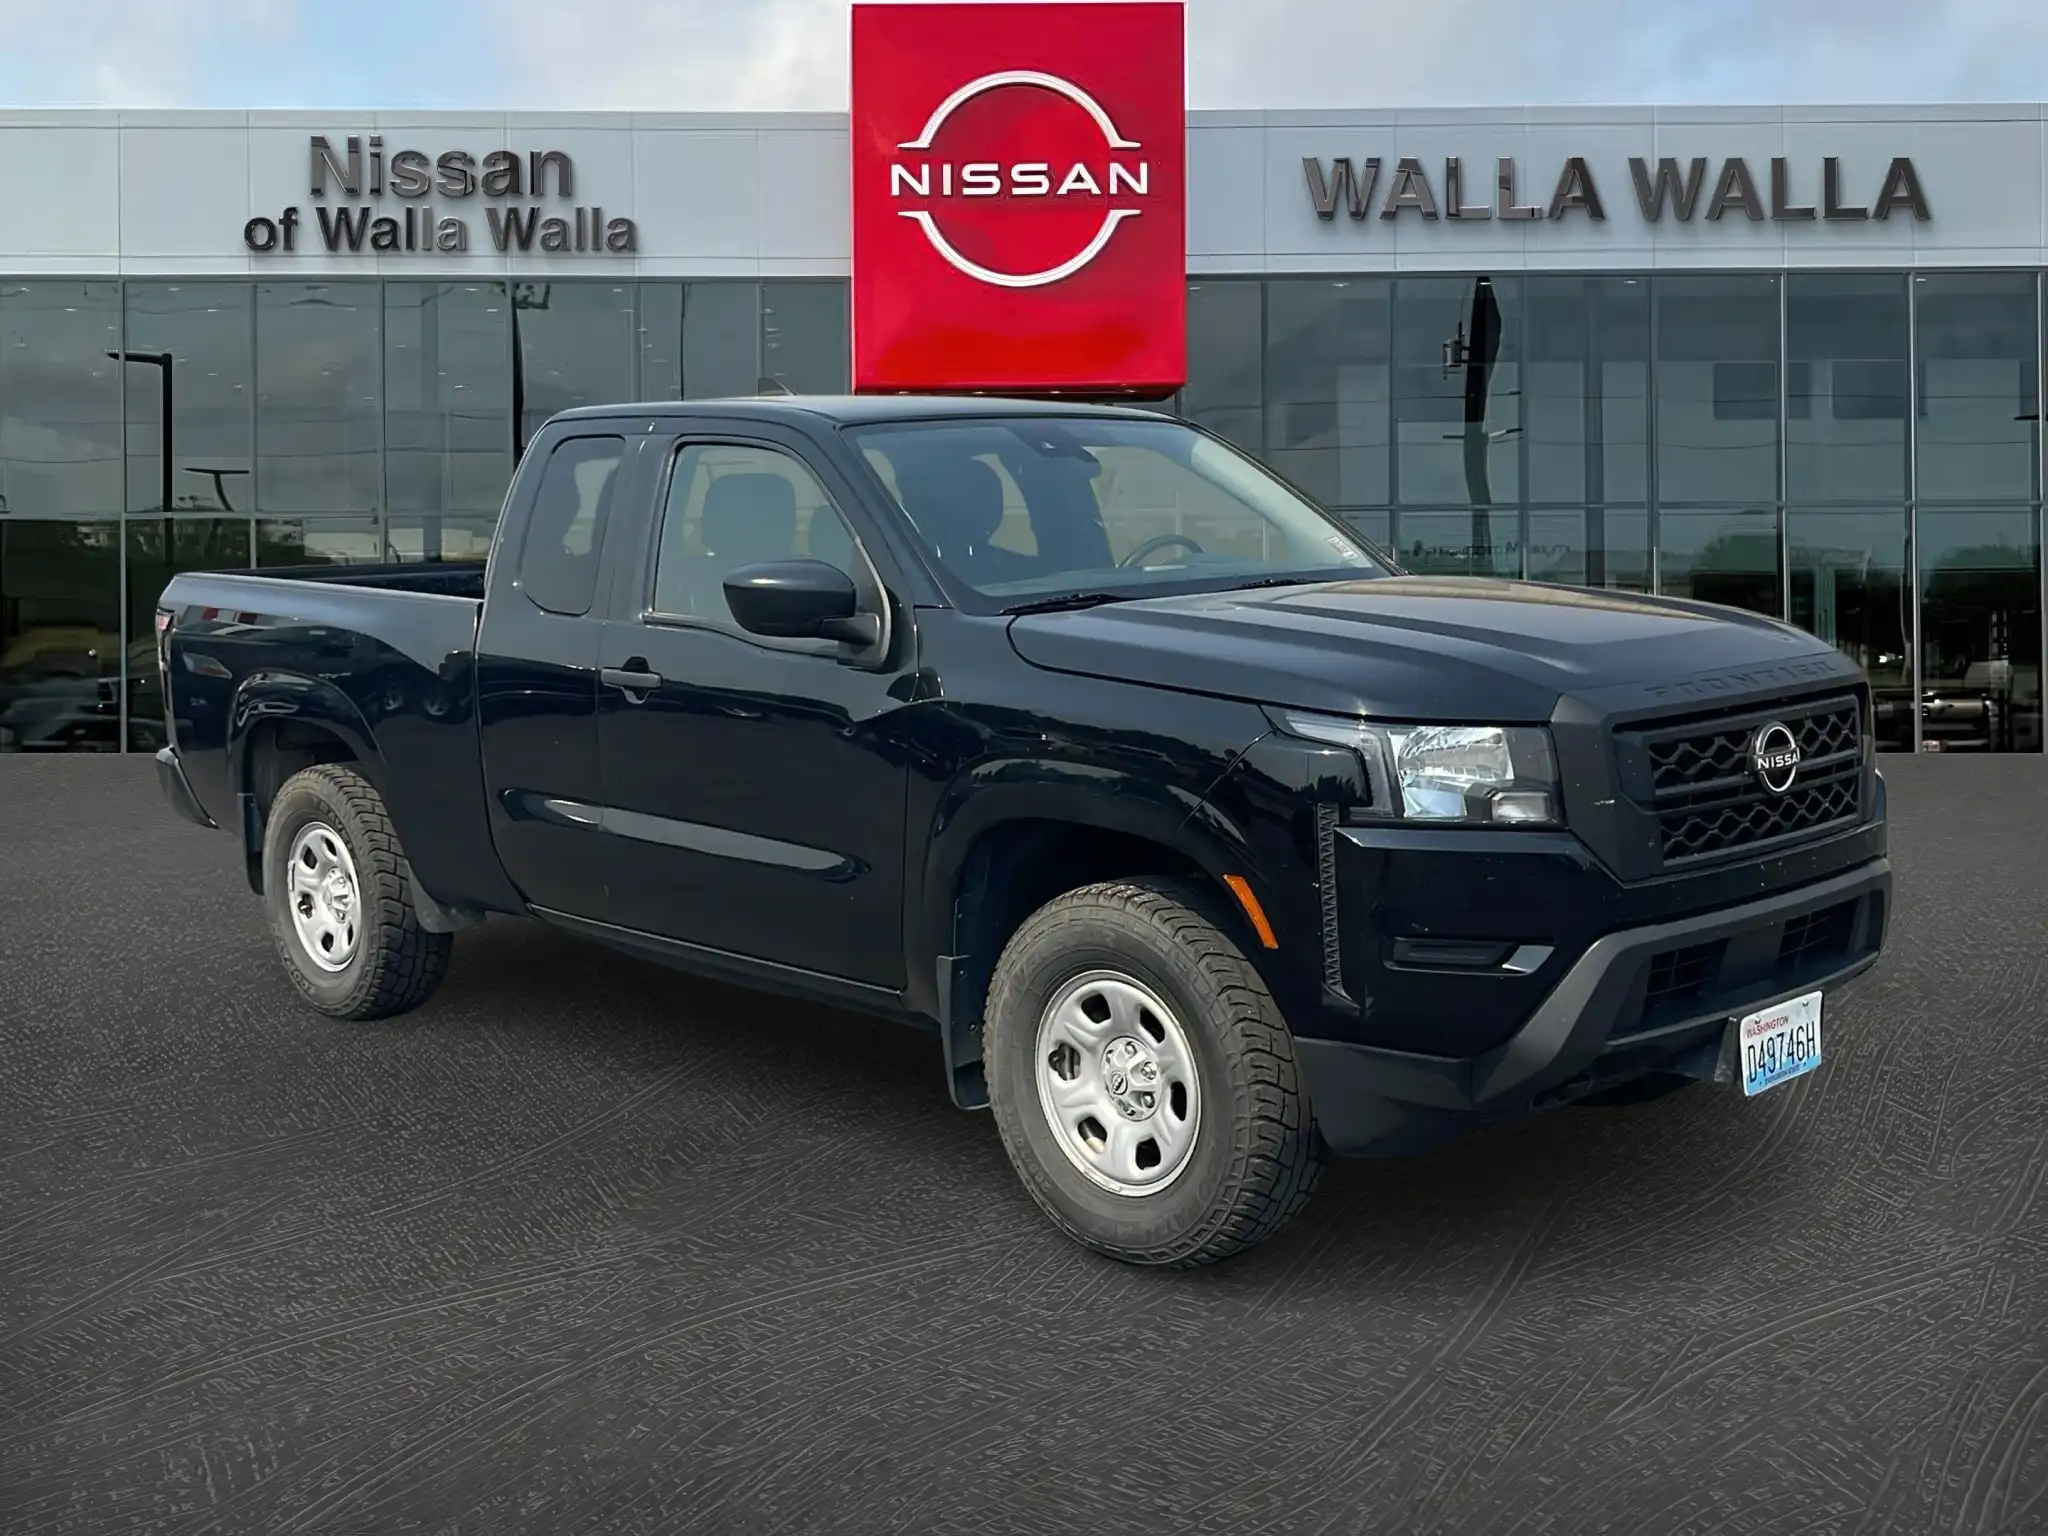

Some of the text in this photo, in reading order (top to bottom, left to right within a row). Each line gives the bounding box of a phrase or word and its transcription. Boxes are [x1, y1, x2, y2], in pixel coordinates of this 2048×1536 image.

[309, 134, 573, 199] Nissan
[890, 162, 1149, 197] NISSAN
[1302, 157, 1932, 221] WALLA WALLA
[244, 206, 638, 253] of Walla Walla
[1644, 660, 1837, 699] FRONTIER
[1745, 1015, 1790, 1039] WASHINGTON
[1747, 1021, 1816, 1083] D49746H
